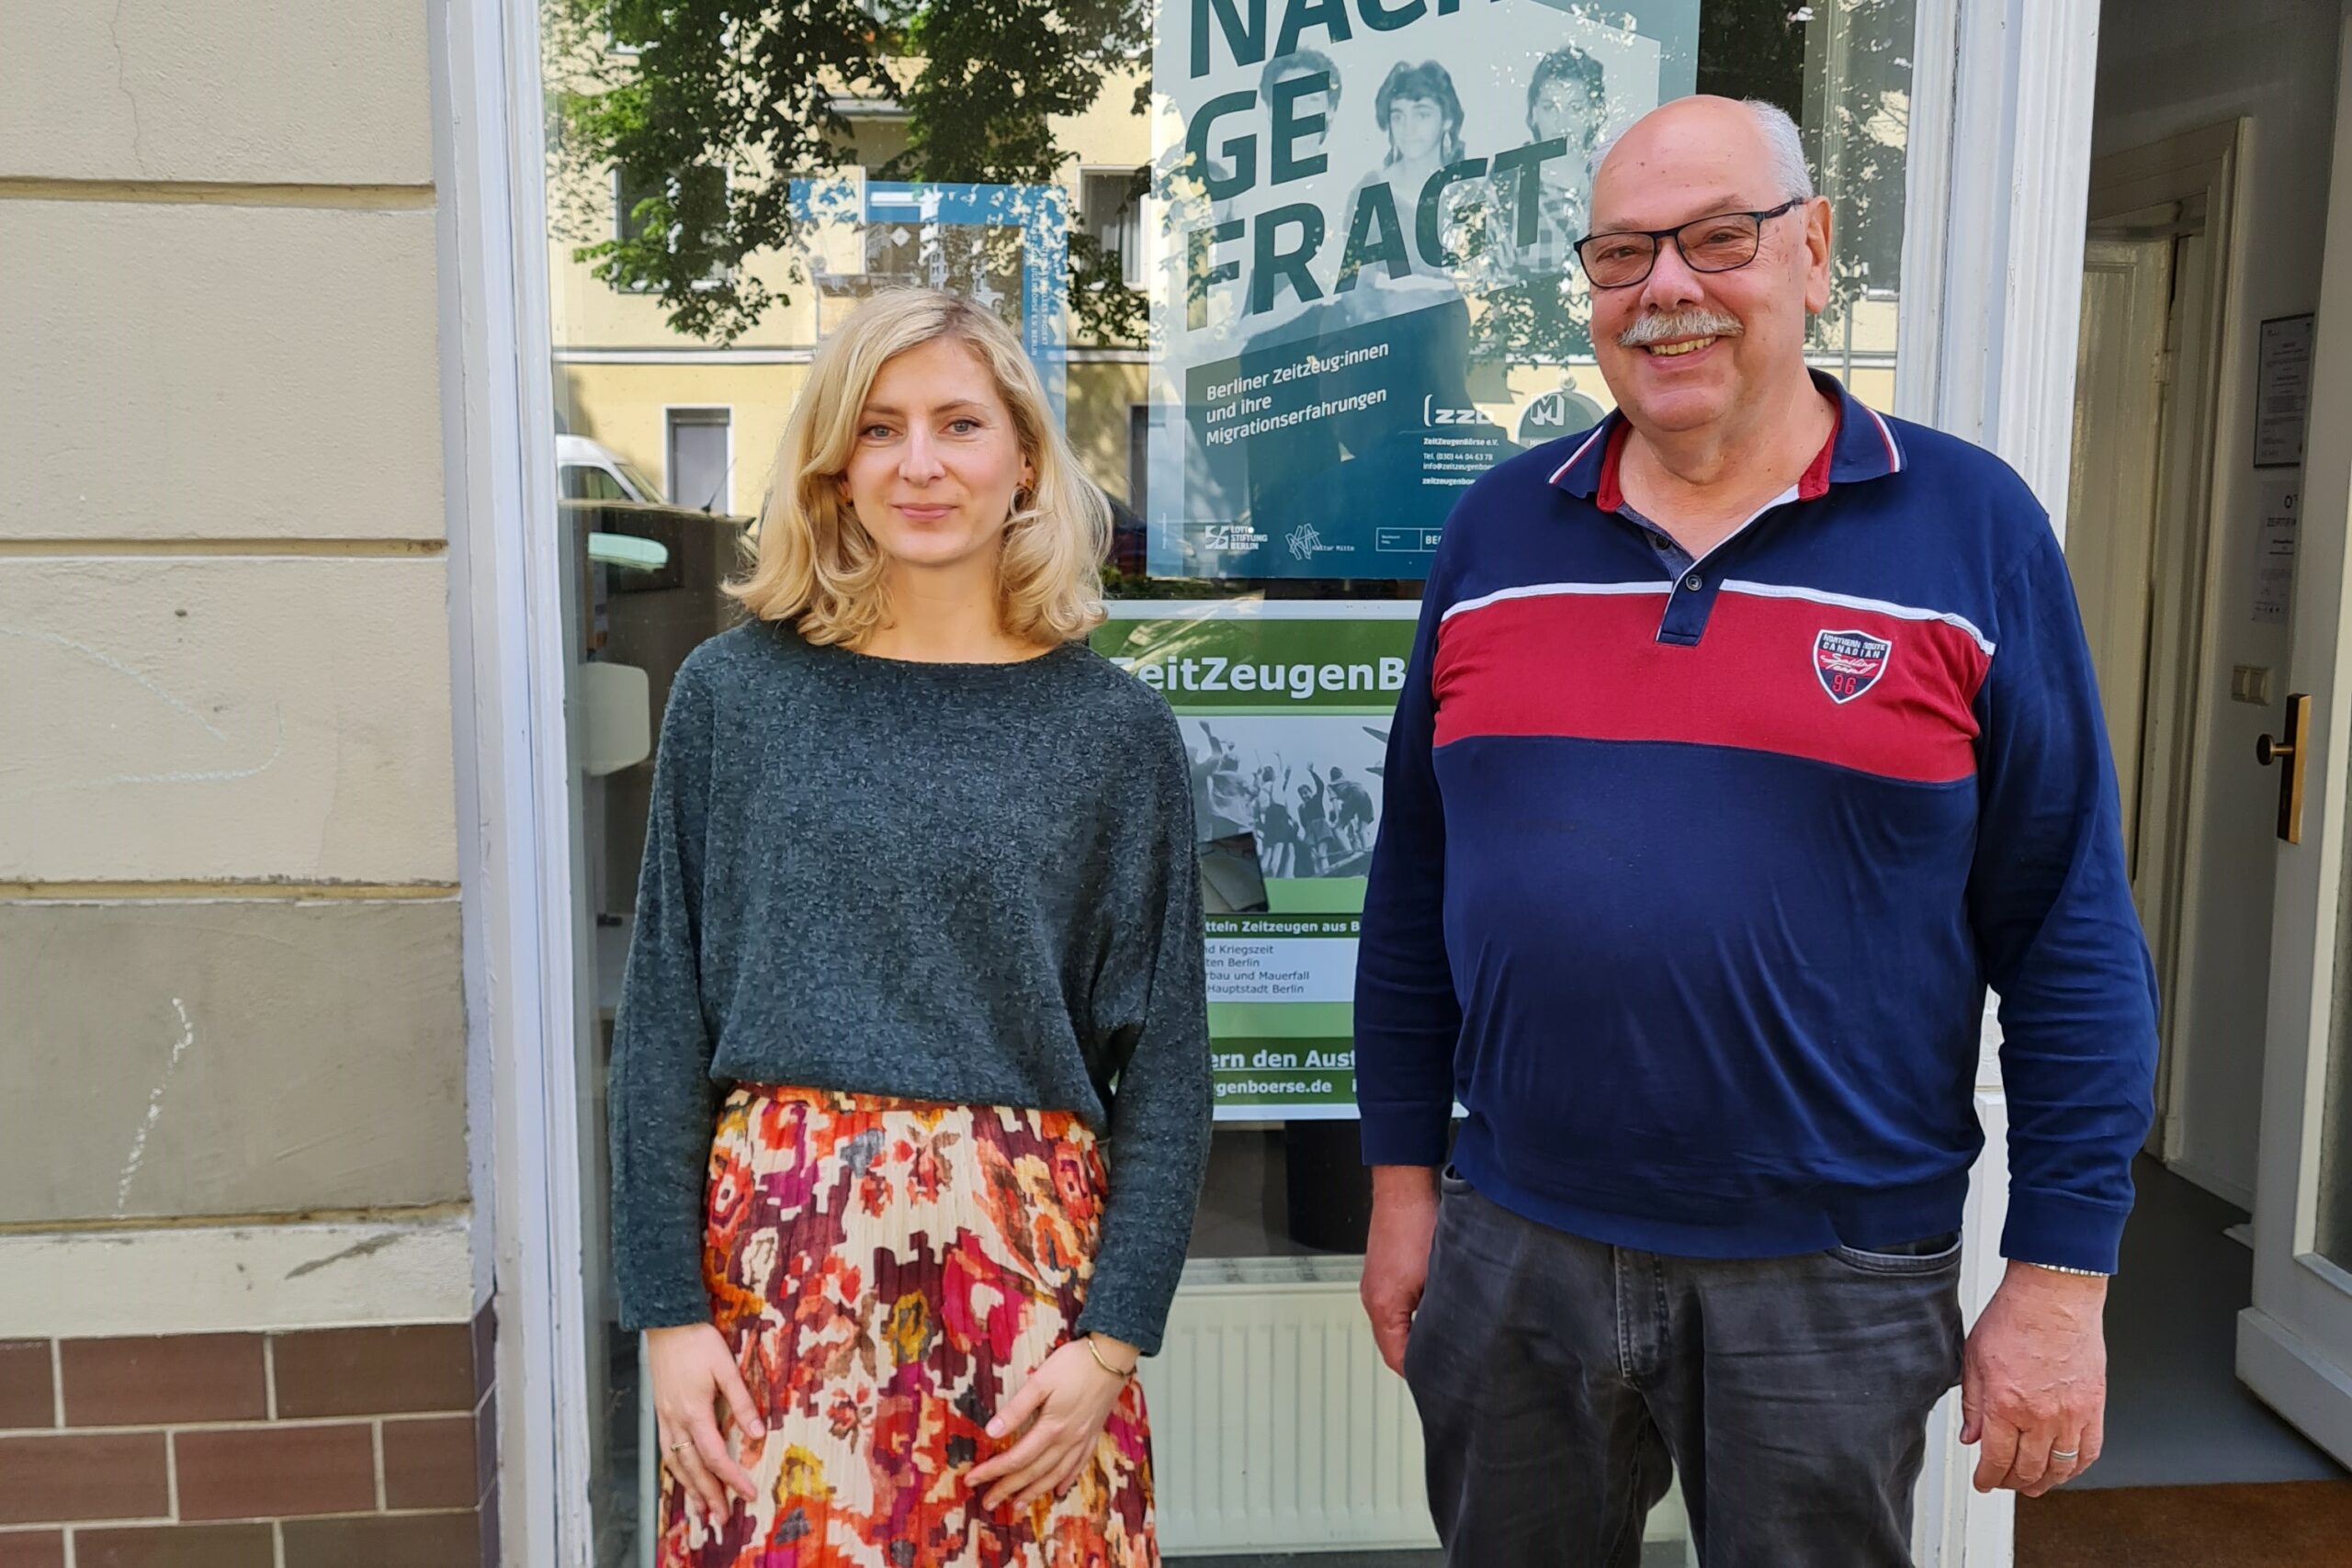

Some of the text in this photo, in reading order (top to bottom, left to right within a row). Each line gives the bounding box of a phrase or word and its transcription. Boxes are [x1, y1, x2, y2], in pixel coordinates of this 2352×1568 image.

[1185, 71, 1330, 202] GE
[1186, 136, 1568, 330] FRAGT
[1206, 343, 1389, 401] Berliner Zeitzeug:innen
[1206, 395, 1272, 423] und ihre
[1206, 388, 1387, 446] Migrationserfahrungen
[1423, 437, 1499, 446] ZeitZeugenBörse e.V.
[1230, 534, 1268, 542] STIFTUNG
[1230, 542, 1260, 550] BERLIN
[1823, 641, 1880, 659] CANADIAN
[1241, 920, 1318, 934] Zeitzeugen
[1321, 922, 1347, 932] aus
[1219, 944, 1274, 955] Kriegszeit
[1227, 958, 1260, 967] Berlin
[1234, 971, 1255, 981] und
[1259, 971, 1310, 981] Mauerfall
[1207, 984, 1305, 995] Hauptstadt Berlin
[1252, 1049, 1297, 1068] den
[1214, 1078, 1332, 1098] genboerse.de
